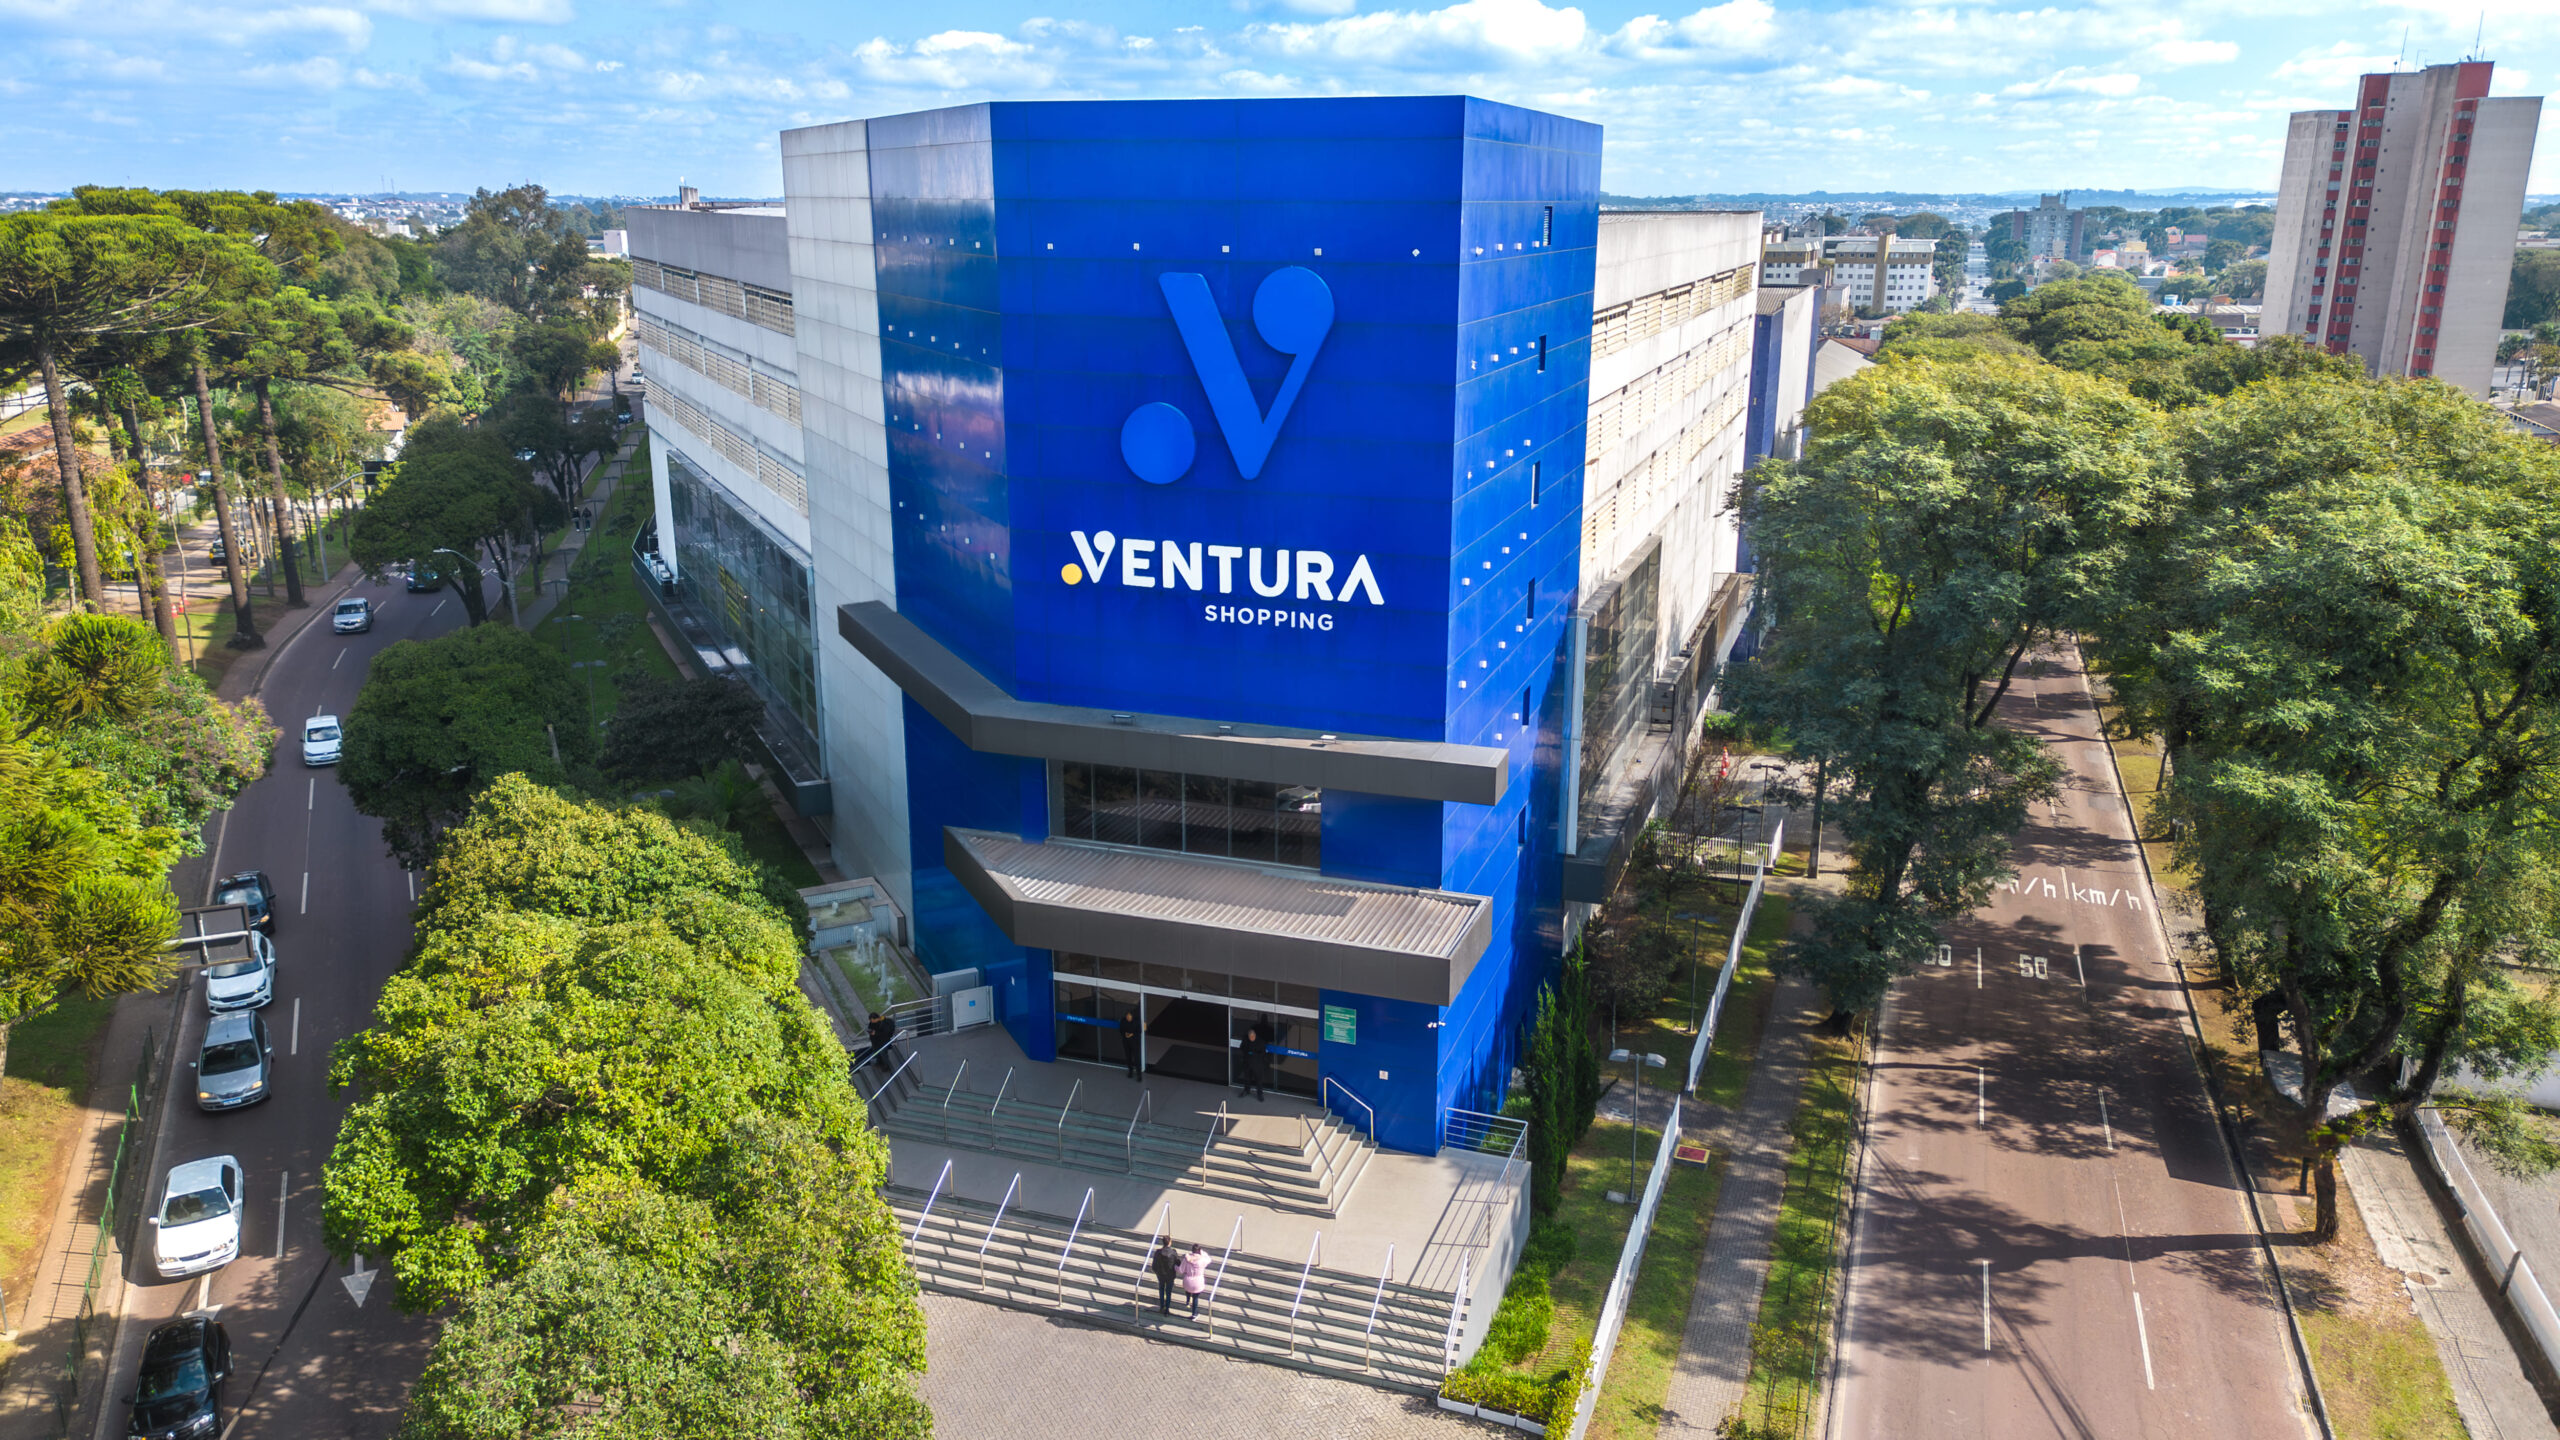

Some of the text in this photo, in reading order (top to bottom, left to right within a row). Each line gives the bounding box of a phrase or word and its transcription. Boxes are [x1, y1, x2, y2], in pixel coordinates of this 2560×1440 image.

[1061, 530, 1385, 605] VENTURA
[1204, 604, 1334, 631] SHOPPING
[2071, 882, 2142, 911] km/h
[2019, 953, 2049, 980] 50
